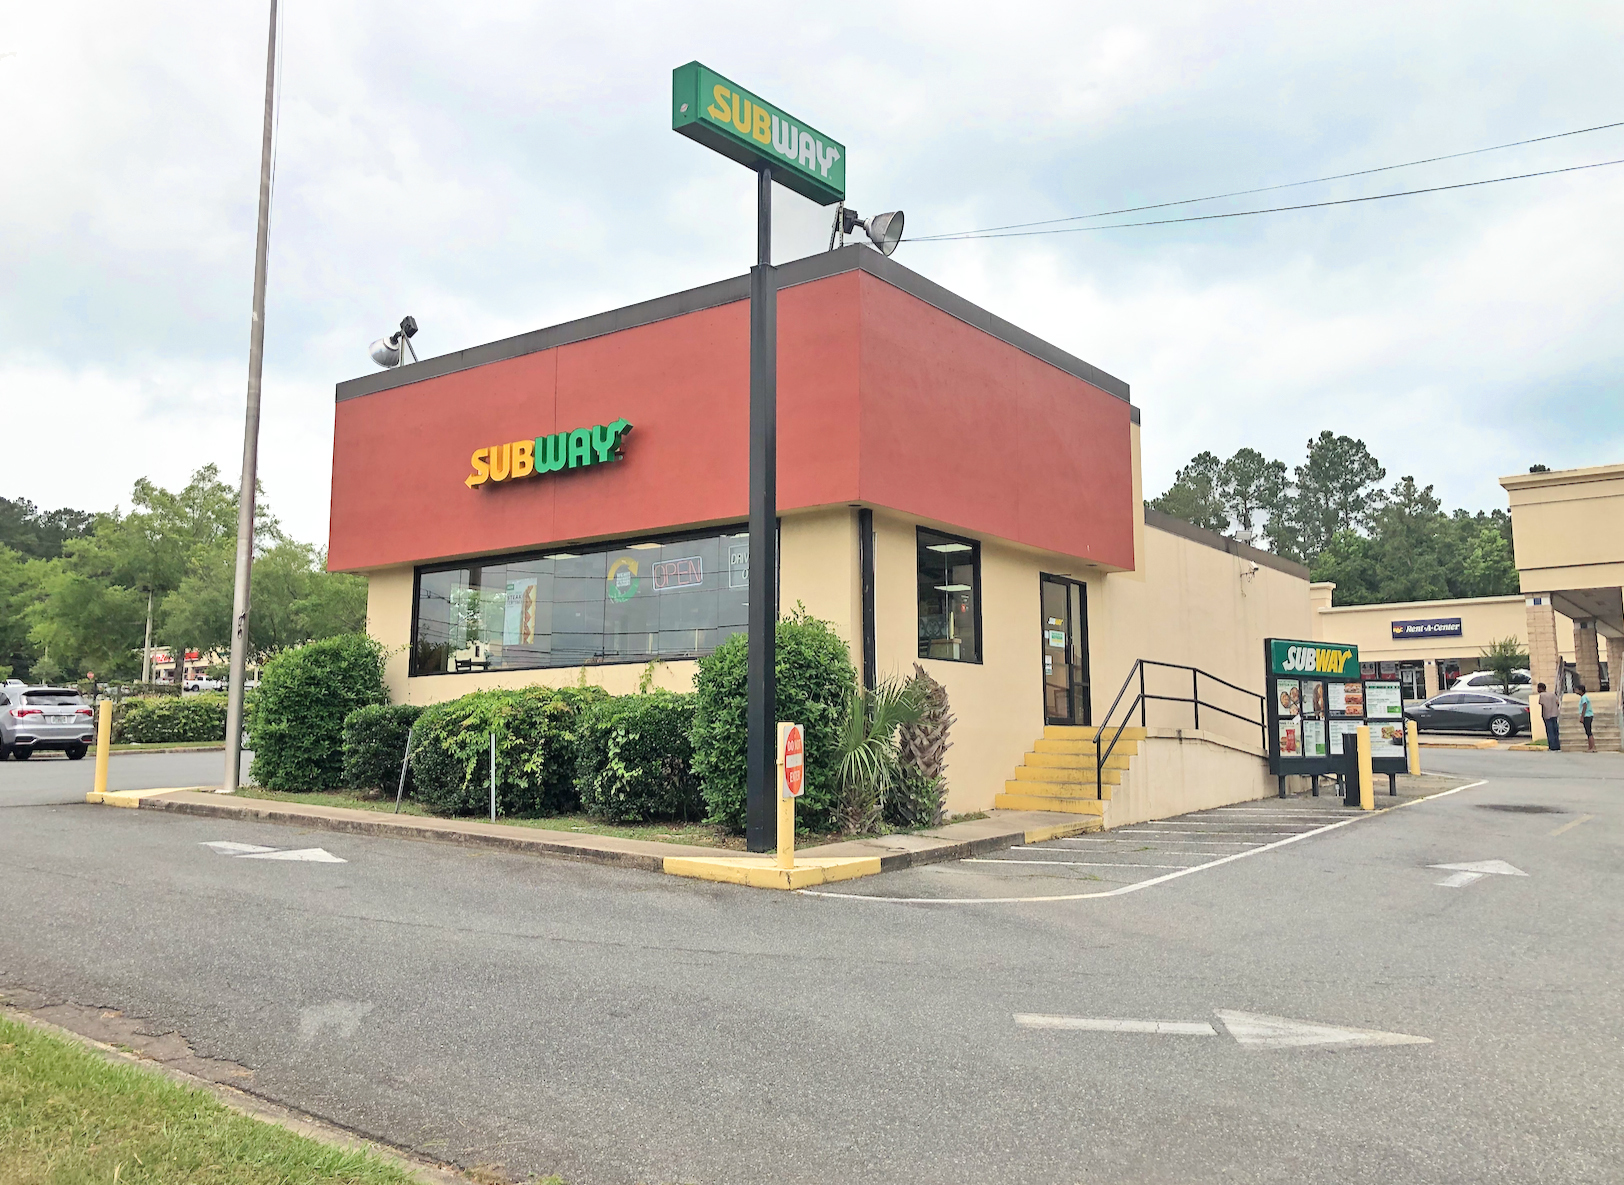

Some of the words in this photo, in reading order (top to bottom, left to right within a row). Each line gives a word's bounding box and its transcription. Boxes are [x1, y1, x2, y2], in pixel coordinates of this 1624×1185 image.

[707, 84, 841, 178] SUBWAY
[464, 417, 634, 490] SUBWAY
[654, 559, 701, 588] OPEN
[730, 553, 749, 565] DRIV
[1282, 644, 1353, 674] SUBWAY
[787, 740, 794, 752] DO
[789, 770, 801, 783] ENTER
